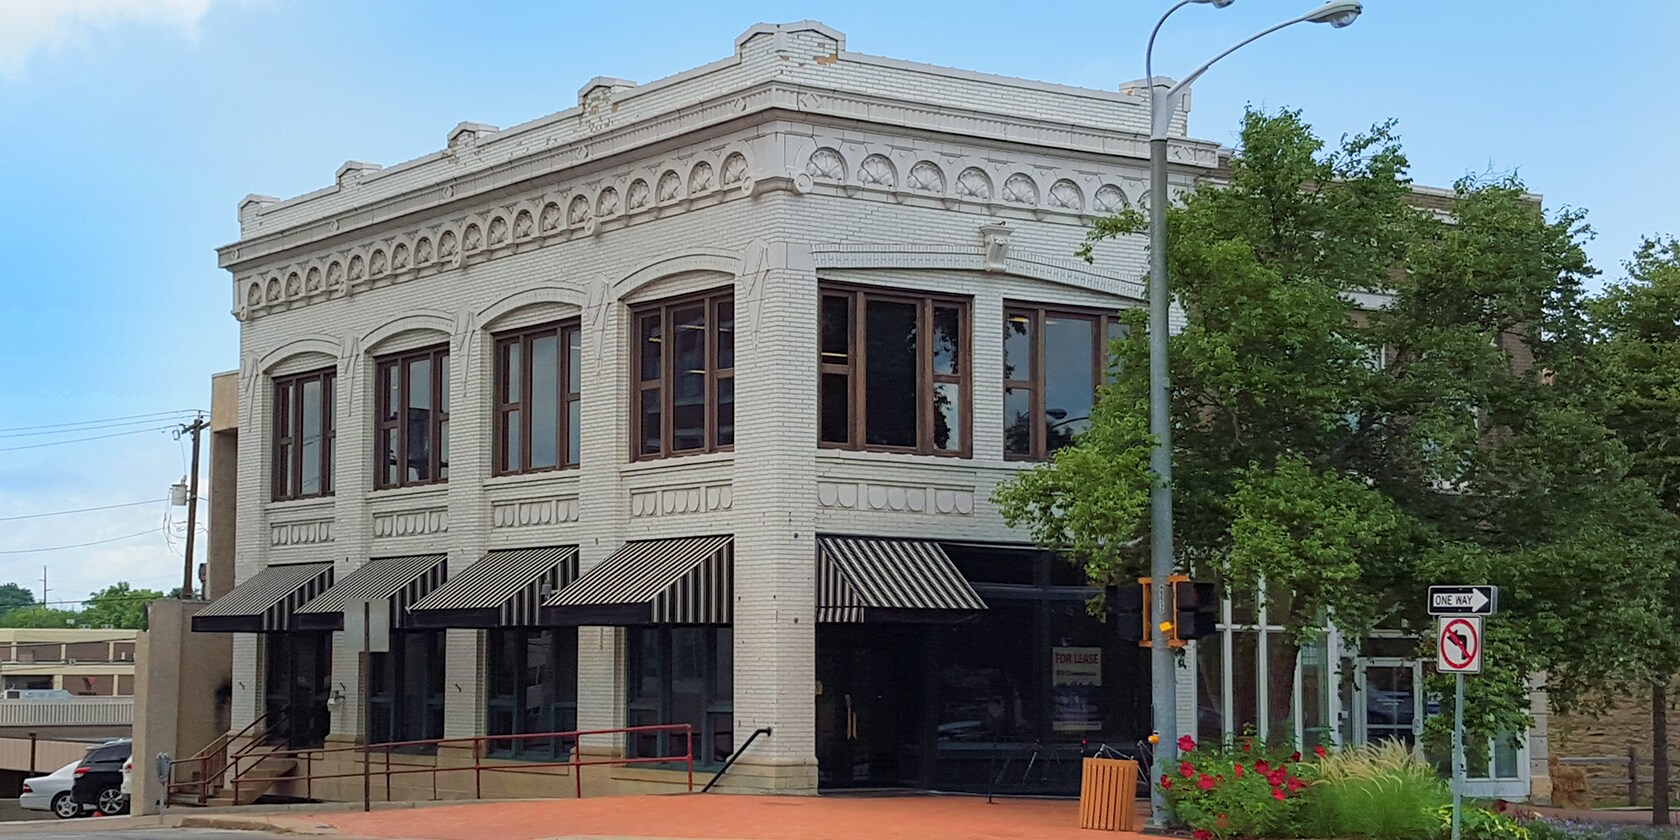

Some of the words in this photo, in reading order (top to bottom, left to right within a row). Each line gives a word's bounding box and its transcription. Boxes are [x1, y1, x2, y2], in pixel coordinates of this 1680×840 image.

[1435, 595, 1453, 605] ONE
[1455, 595, 1473, 605] WAY
[1056, 653, 1072, 664] FOR
[1074, 653, 1099, 664] LEASE
